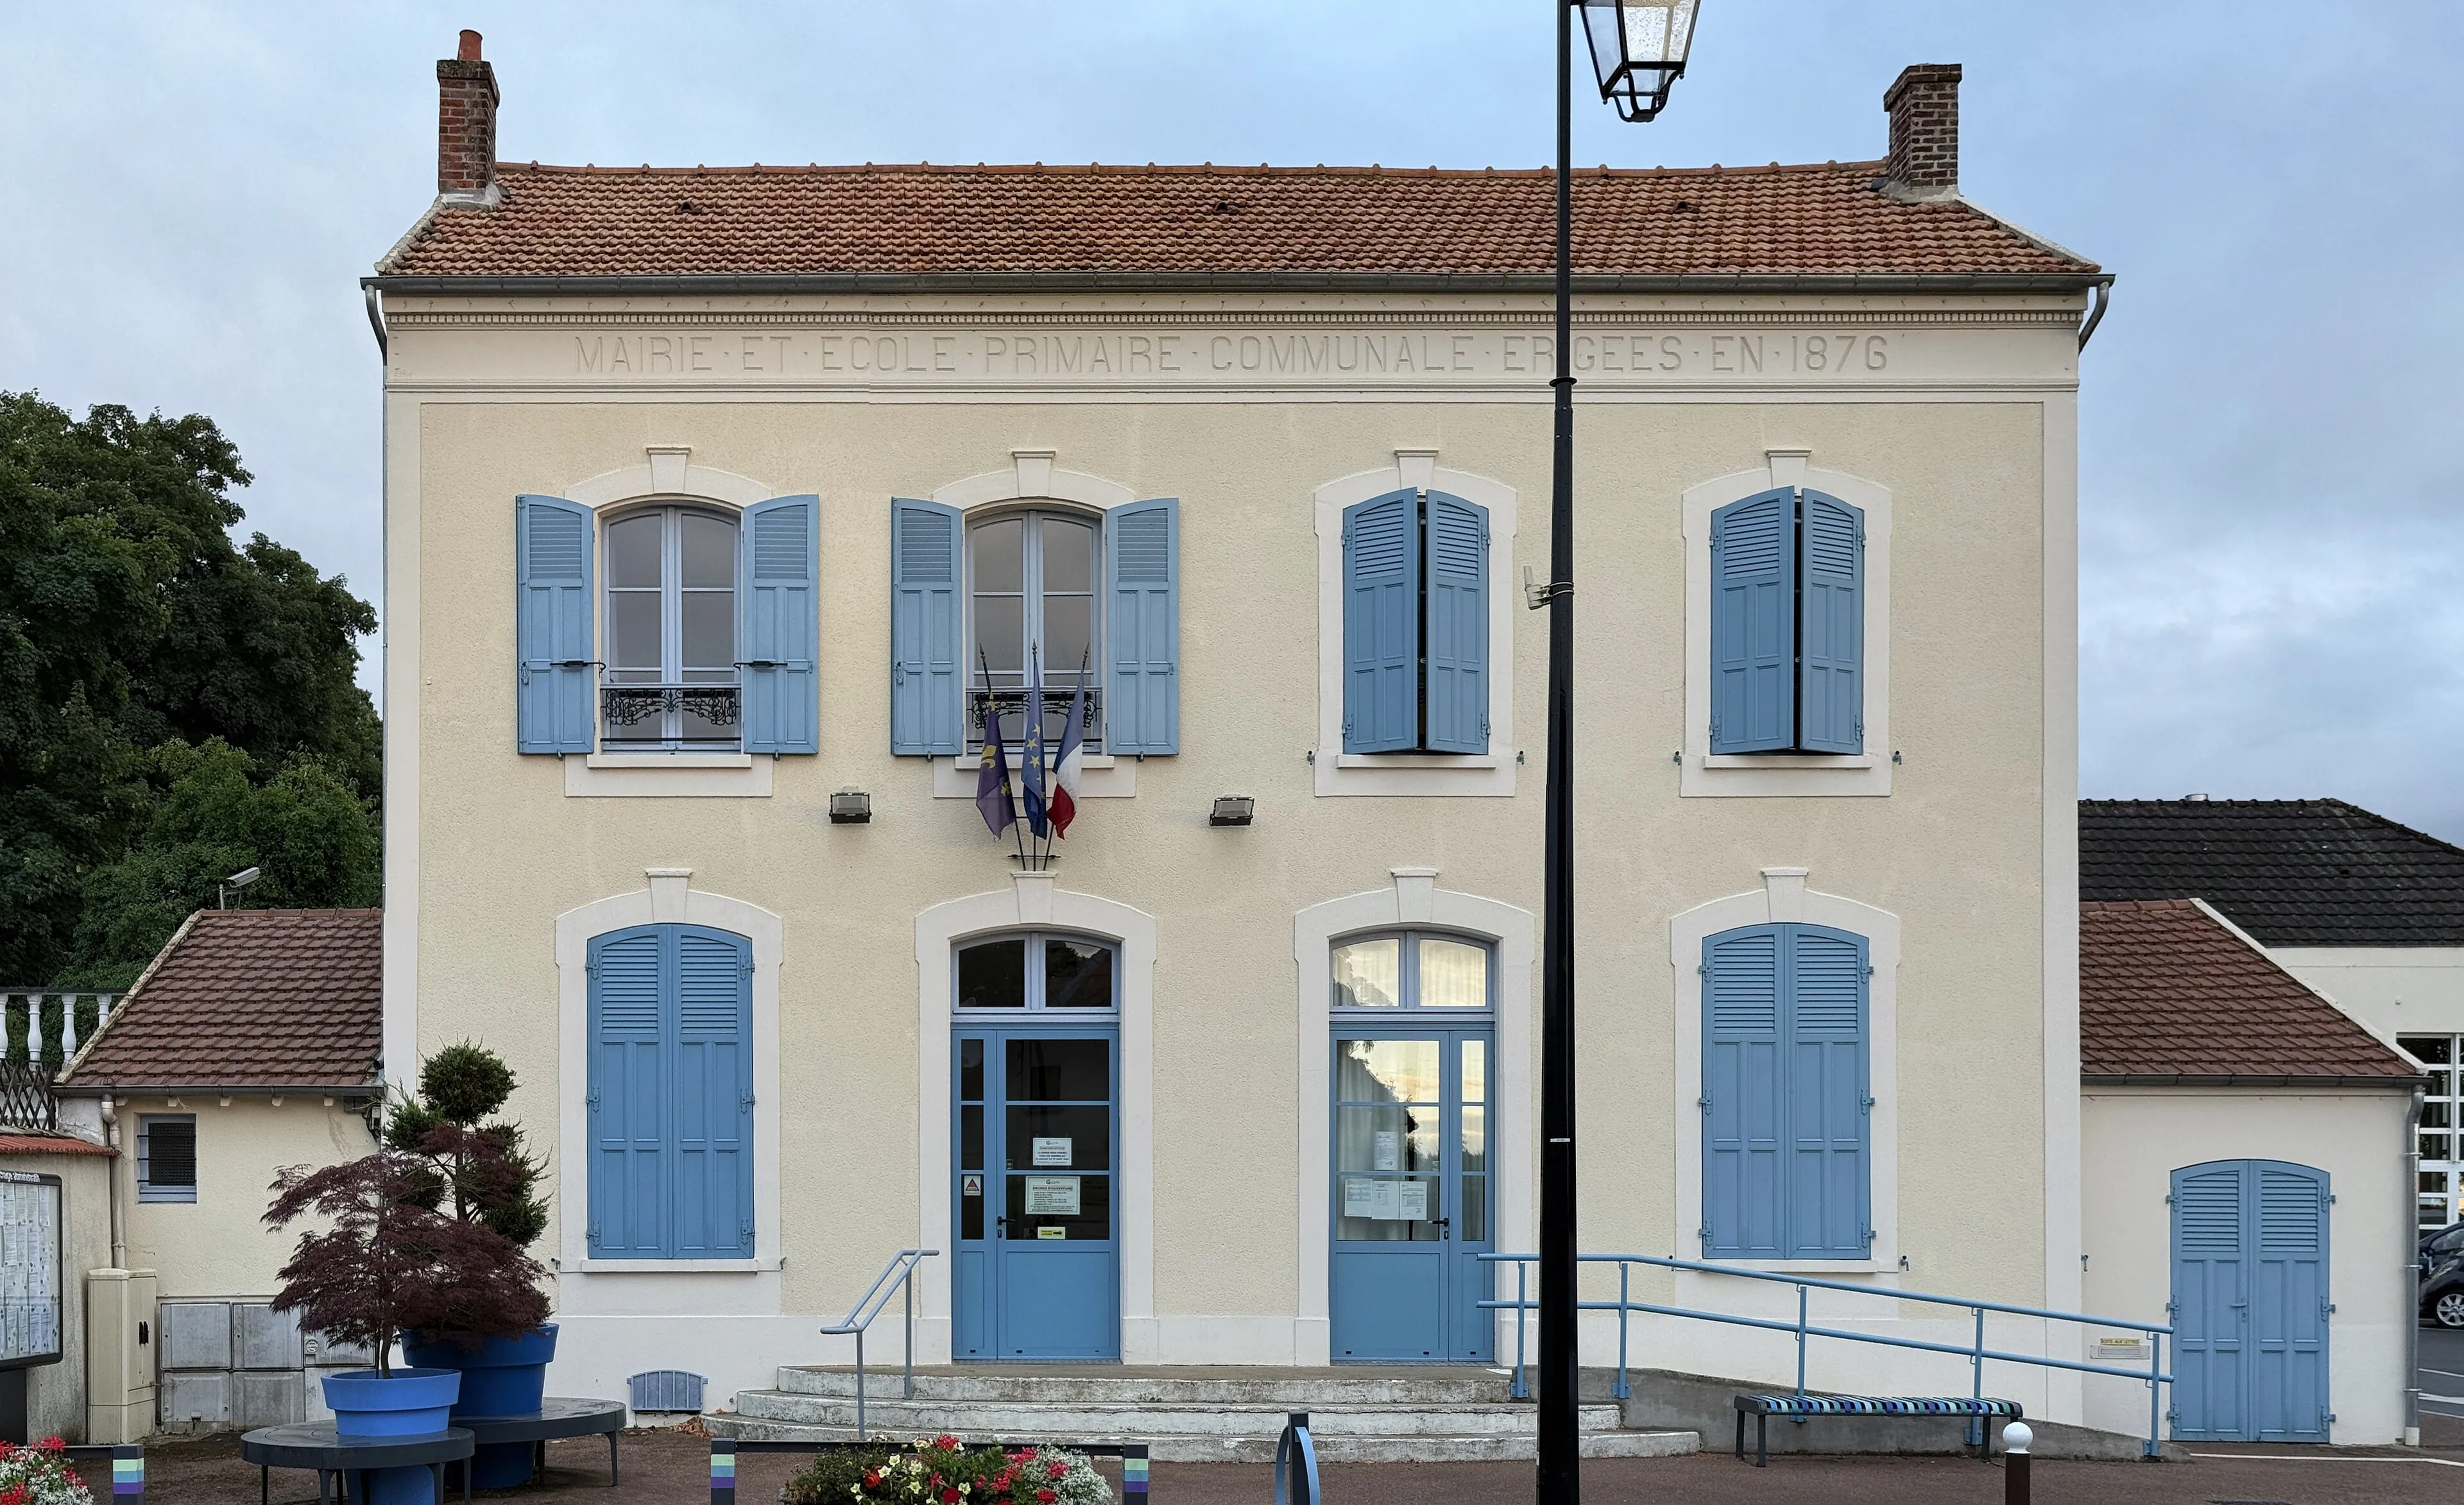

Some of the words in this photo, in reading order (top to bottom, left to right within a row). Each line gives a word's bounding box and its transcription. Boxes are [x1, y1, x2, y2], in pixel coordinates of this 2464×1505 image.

[574, 336, 712, 373] MAIRIE
[740, 336, 792, 373] ET
[820, 336, 955, 373] ECOLE
[984, 336, 1181, 373] PRIMAIRE
[1210, 336, 1475, 373] COMMUNALE
[1502, 335, 1682, 372] ERGEES
[1711, 335, 1764, 372] EN
[1792, 335, 1888, 372] 1876
